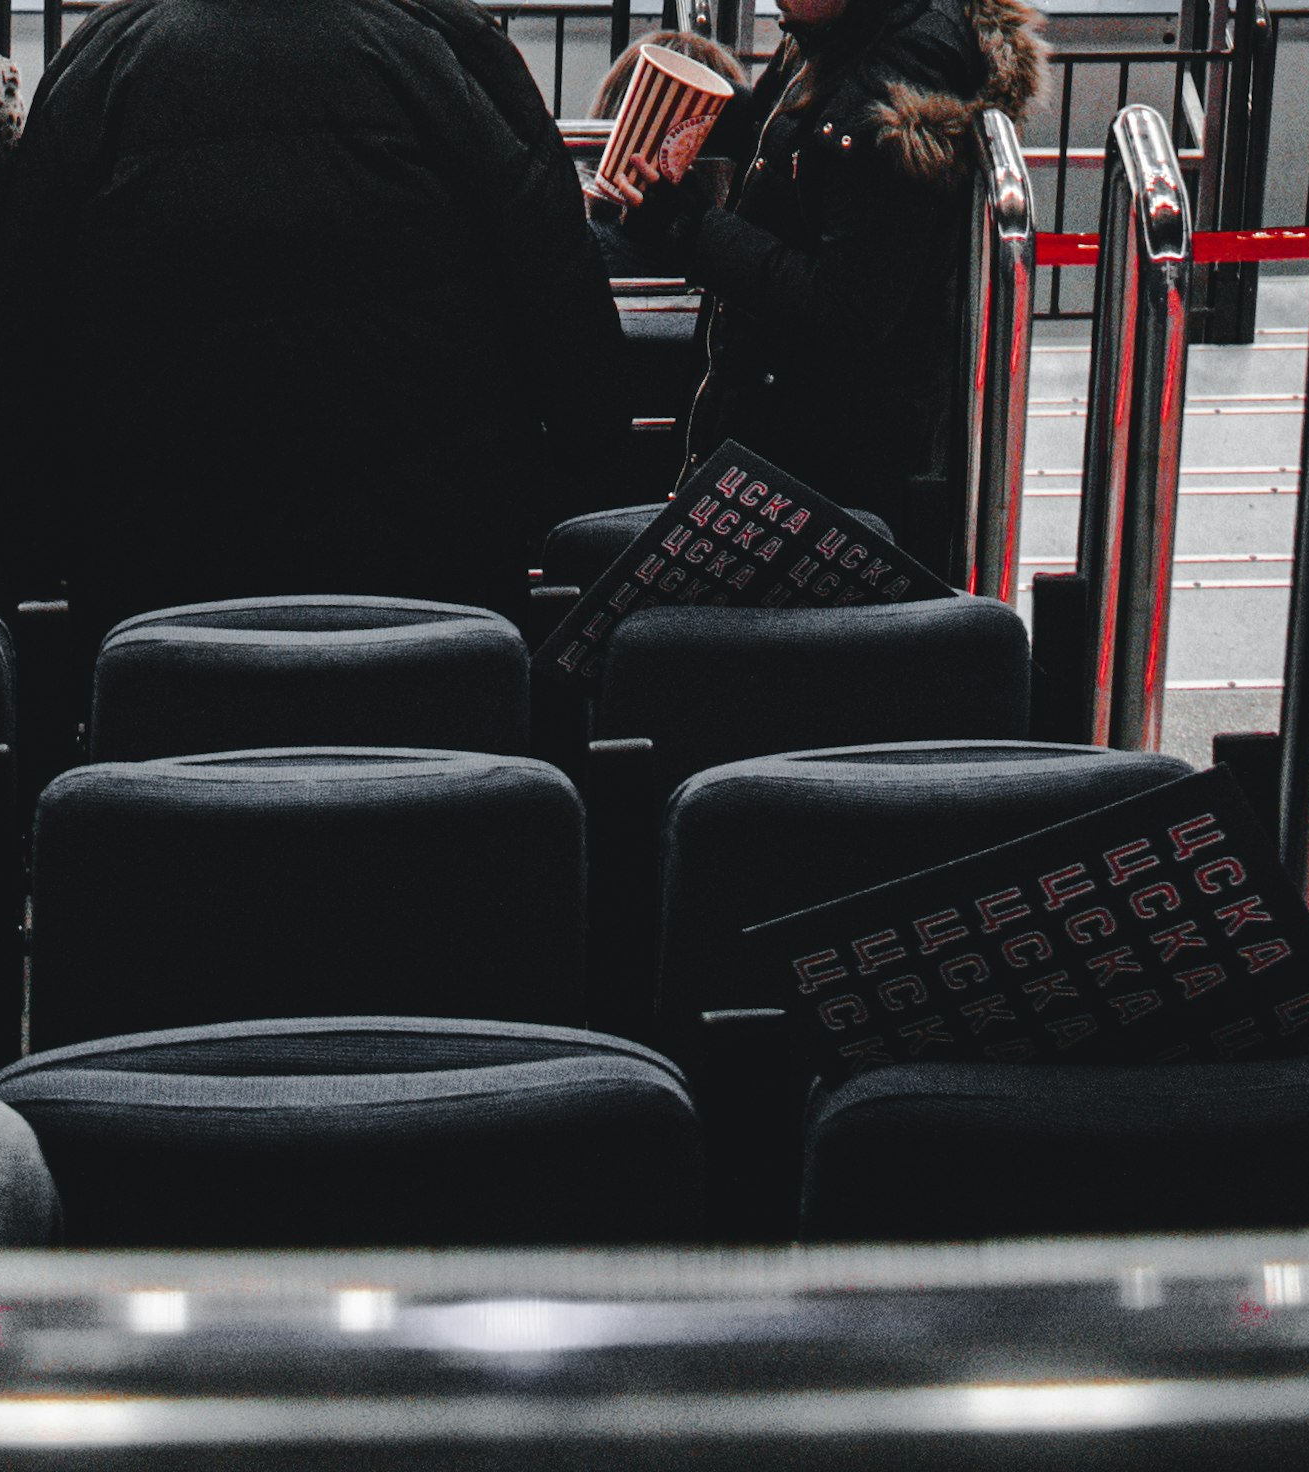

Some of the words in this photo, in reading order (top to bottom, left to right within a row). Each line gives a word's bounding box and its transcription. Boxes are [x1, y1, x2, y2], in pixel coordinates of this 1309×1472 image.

[661, 523, 758, 592] ЦСКА
[688, 494, 785, 563] ЦСКА
[714, 464, 812, 536] ЦСКА
[814, 526, 913, 602] ЦСКА
[1037, 862, 1164, 1026] ЦСКА
[1101, 837, 1229, 1001] ЦСКА
[1165, 811, 1293, 975] ЦСКА
[973, 886, 1102, 1053] ЦСКА
